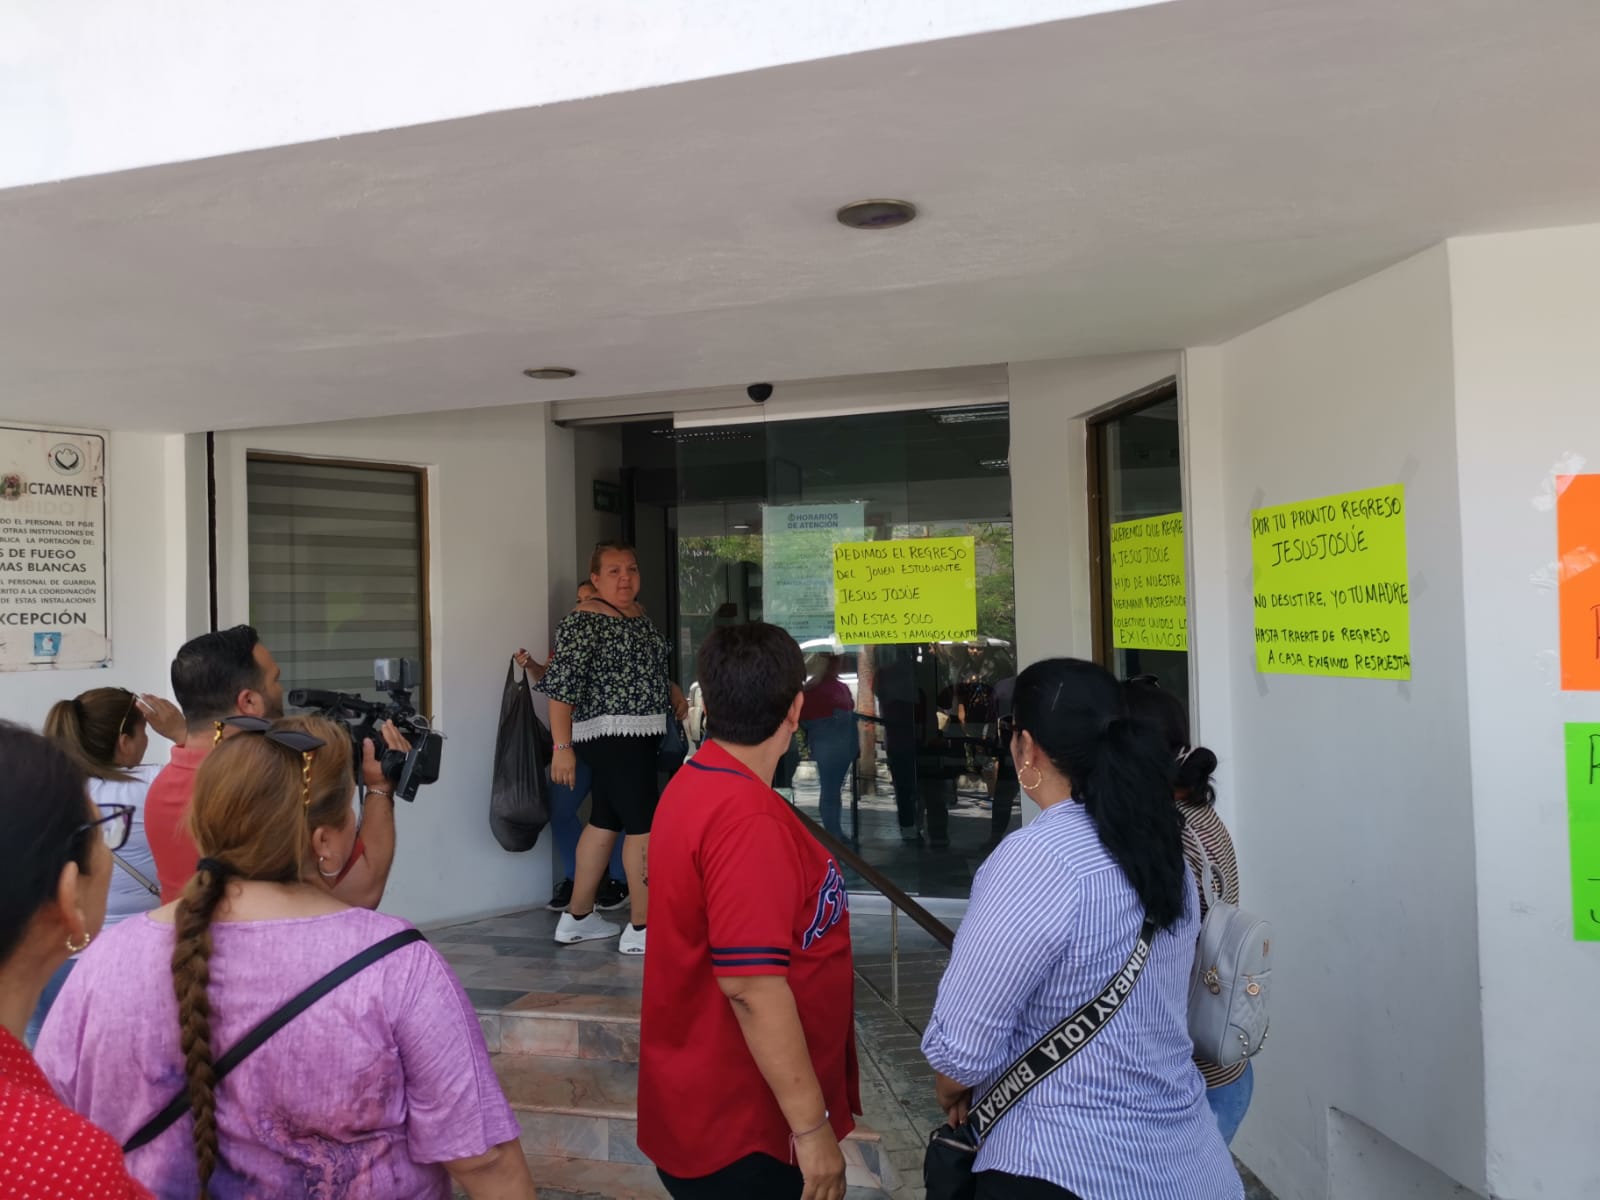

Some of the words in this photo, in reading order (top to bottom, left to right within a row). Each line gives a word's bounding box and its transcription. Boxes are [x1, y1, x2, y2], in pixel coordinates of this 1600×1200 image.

[797, 512, 838, 521] HORARIOS
[800, 519, 838, 529] ATENCIÓN
[1252, 515, 1270, 539] POR
[1273, 513, 1287, 532] TU
[1291, 505, 1337, 530] PRONTO
[1341, 496, 1402, 520] REGRESO
[1145, 523, 1160, 538] QUE
[39, 537, 80, 545] PORTACIÓN
[9, 549, 26, 558] DE
[31, 549, 76, 559] FUEGO
[835, 547, 887, 561] PEDIMOS
[893, 546, 904, 559] EL
[909, 546, 967, 560] REGRESO
[1112, 552, 1117, 566] A
[1118, 549, 1142, 568] JESUS
[28, 562, 87, 573] BLANCAS
[836, 569, 856, 580] DEL
[901, 563, 962, 575] ESTUDIANTE
[1133, 576, 1144, 590] DE
[1146, 574, 1181, 588] NUESTRA
[39, 587, 96, 595] COORDINACIÓN
[840, 588, 877, 603] JESUS
[1254, 593, 1267, 608] NO
[1330, 589, 1347, 609] YO
[840, 613, 858, 625] NO
[863, 613, 898, 625] ESTAS
[903, 612, 934, 625] SOLO
[839, 629, 898, 640] FAMILIARES
[909, 629, 946, 640] AMIGOS
[1255, 627, 1279, 643] HASTA
[1281, 628, 1319, 643] TRAERTE
[1322, 630, 1335, 642] DE
[1340, 627, 1391, 643] REGRESO
[1268, 649, 1275, 665] A
[1279, 652, 1304, 667] CASA
[1355, 653, 1410, 671] RESPUESTA
[1039, 1014, 1096, 1062] LOLA
